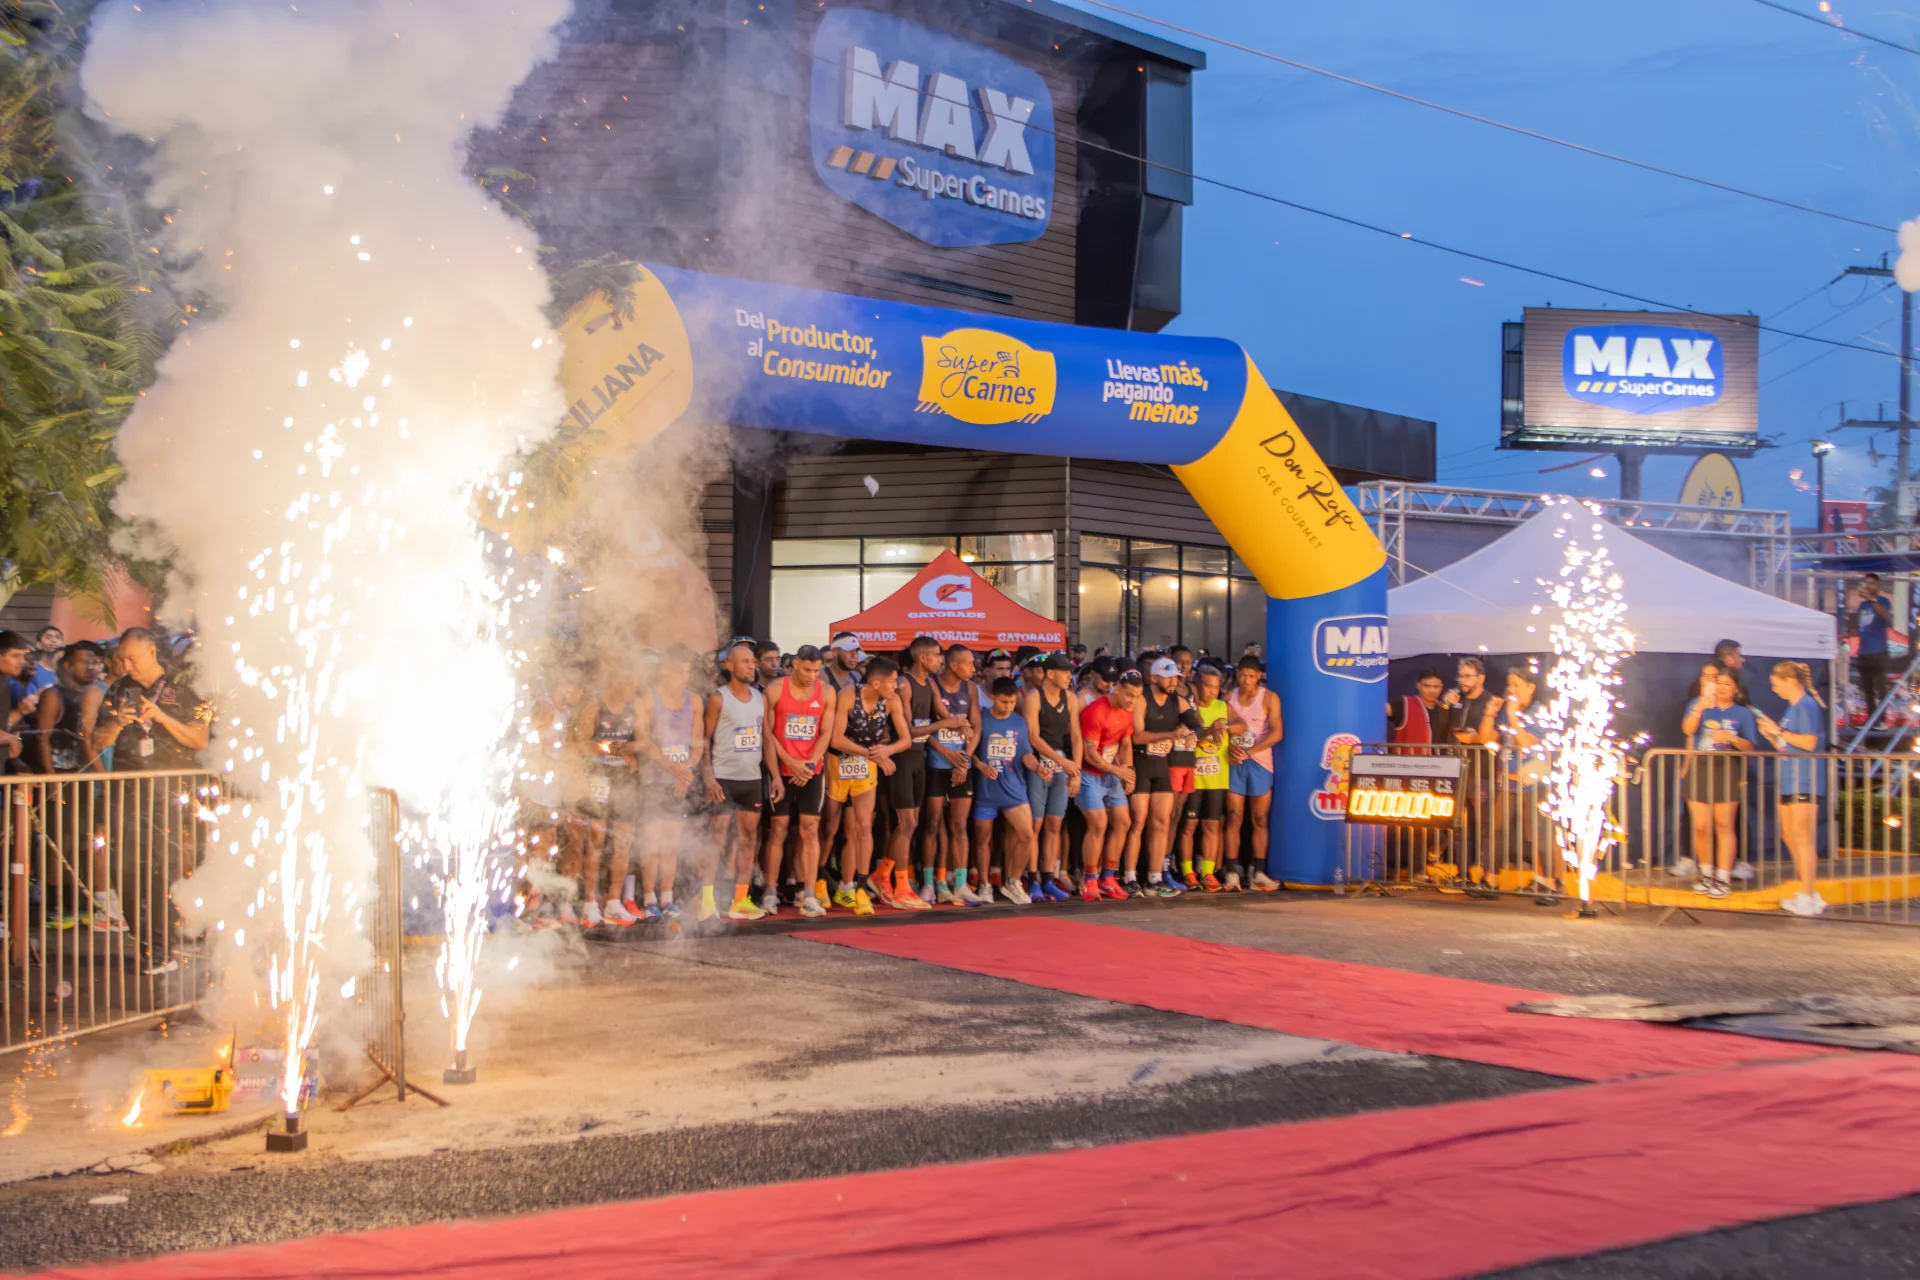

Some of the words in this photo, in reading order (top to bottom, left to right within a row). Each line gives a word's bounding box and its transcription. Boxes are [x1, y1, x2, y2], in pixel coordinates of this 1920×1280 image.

[844, 46, 1035, 176] MAX
[897, 157, 1046, 220] SuperCarnes
[735, 309, 766, 330] Del
[766, 318, 878, 360] Productor,
[747, 338, 763, 358] al
[763, 350, 892, 389] Consumidor
[1573, 334, 1716, 380] MAX
[937, 345, 998, 398] Super
[1106, 358, 1160, 383] Llevas
[1160, 360, 1209, 391] más,
[964, 375, 1036, 405] Carnes
[1103, 380, 1174, 405] pagando
[1618, 378, 1716, 398] SuperCarnes
[1129, 401, 1201, 425] menos
[1259, 430, 1305, 480] Don
[1297, 470, 1357, 532] Rafa
[1257, 466, 1282, 496] CAFÉ
[1280, 497, 1324, 550] GOURMET
[907, 611, 986, 619] GATORADE
[997, 632, 1061, 643] GATORADE
[741, 735, 757, 746] 812
[787, 723, 815, 735] 1043
[991, 745, 1013, 756] 1142
[1152, 743, 1170, 753] 958
[840, 763, 867, 774] 1086
[1197, 765, 1219, 774] 465
